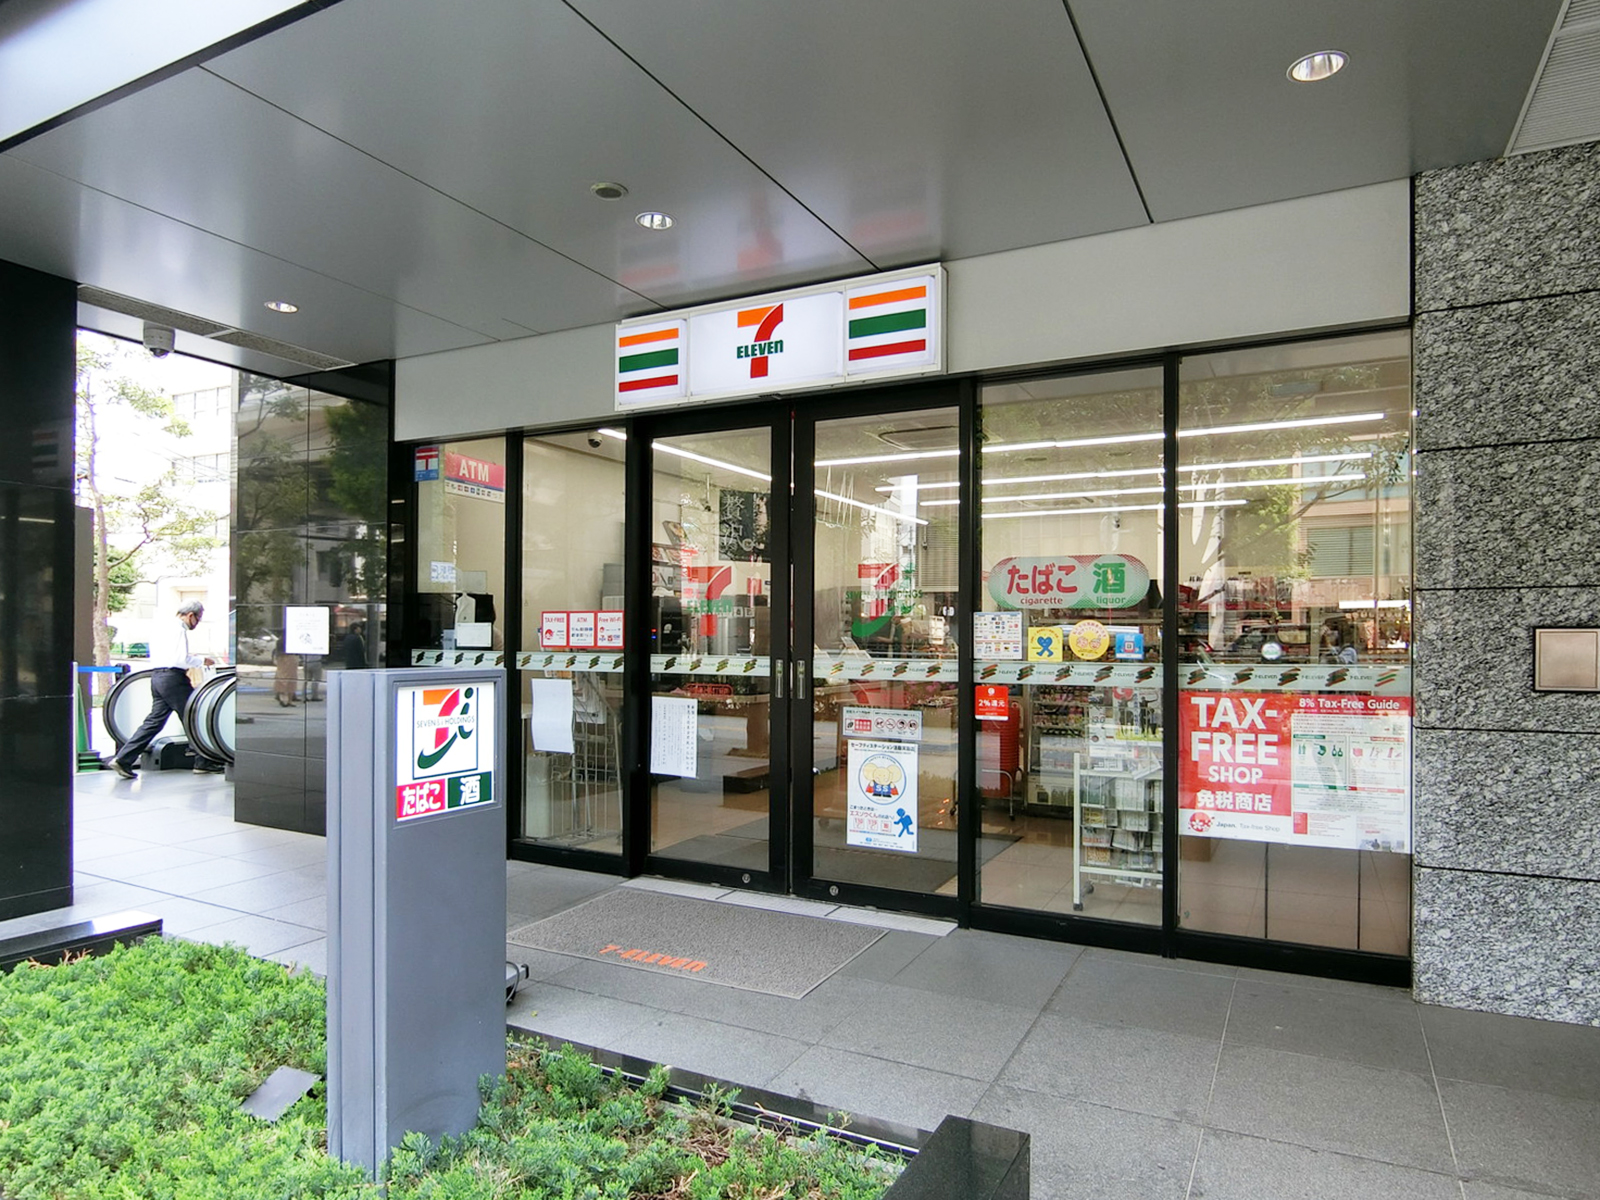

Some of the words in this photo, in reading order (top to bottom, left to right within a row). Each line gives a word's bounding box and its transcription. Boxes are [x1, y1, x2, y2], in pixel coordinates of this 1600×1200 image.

[737, 303, 784, 379] 7
[459, 459, 489, 483] ATM
[1006, 562, 1078, 595] たばこ
[1092, 562, 1126, 594] 酒
[1020, 596, 1063, 606] cigarette
[1096, 595, 1126, 606] liquor
[1191, 697, 1278, 730] TAX-
[1298, 697, 1315, 708] 8%
[1318, 698, 1364, 709] Tax-Free
[1367, 699, 1400, 710] Guide
[445, 716, 475, 726] HOLDINGS
[1191, 731, 1279, 766] FREE
[1208, 767, 1263, 785] SHOP
[402, 782, 442, 816] たばこ
[459, 774, 481, 806] 酒
[1196, 789, 1272, 812] 免税商店
[1264, 825, 1281, 833] Shop
